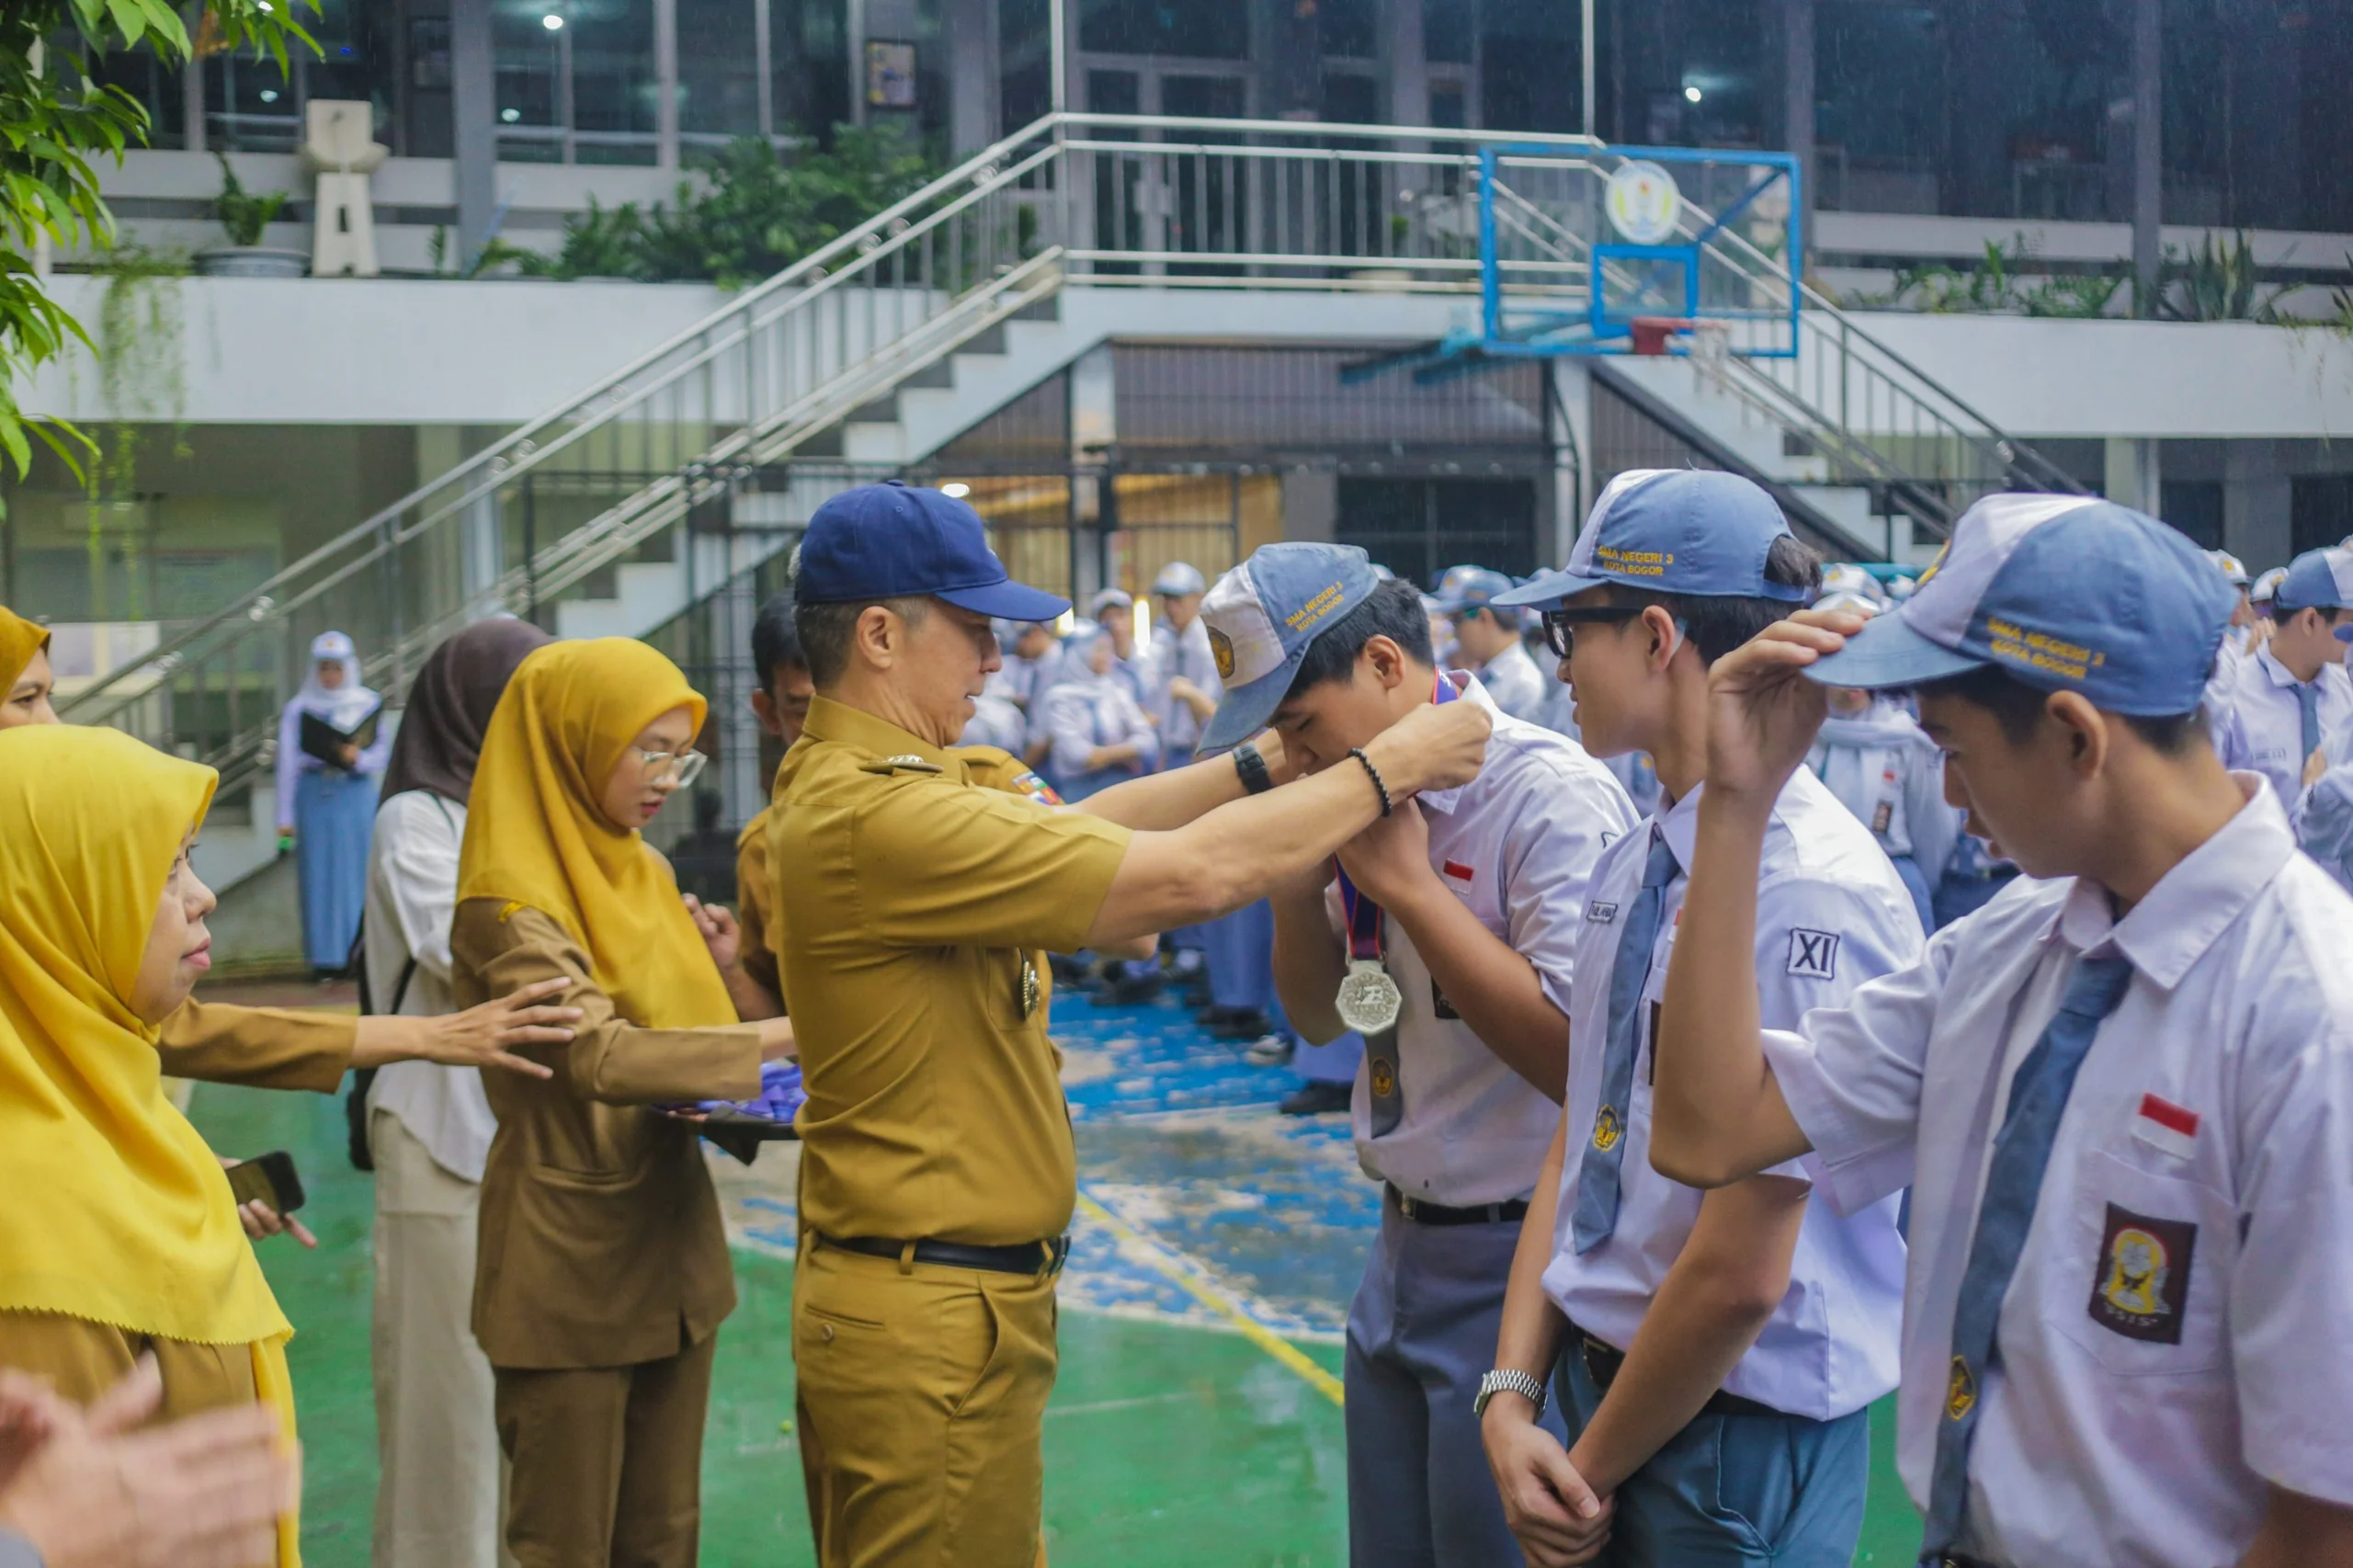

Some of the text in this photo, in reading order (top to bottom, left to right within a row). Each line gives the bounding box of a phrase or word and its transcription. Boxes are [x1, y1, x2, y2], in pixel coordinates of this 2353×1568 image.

[1598, 545, 1674, 564] SMA NEGERI 3
[1628, 564, 1664, 576] BOGOR
[1285, 609, 1306, 627] SMA
[1305, 585, 1336, 612] NEGERI
[1794, 933, 1832, 972] XI
